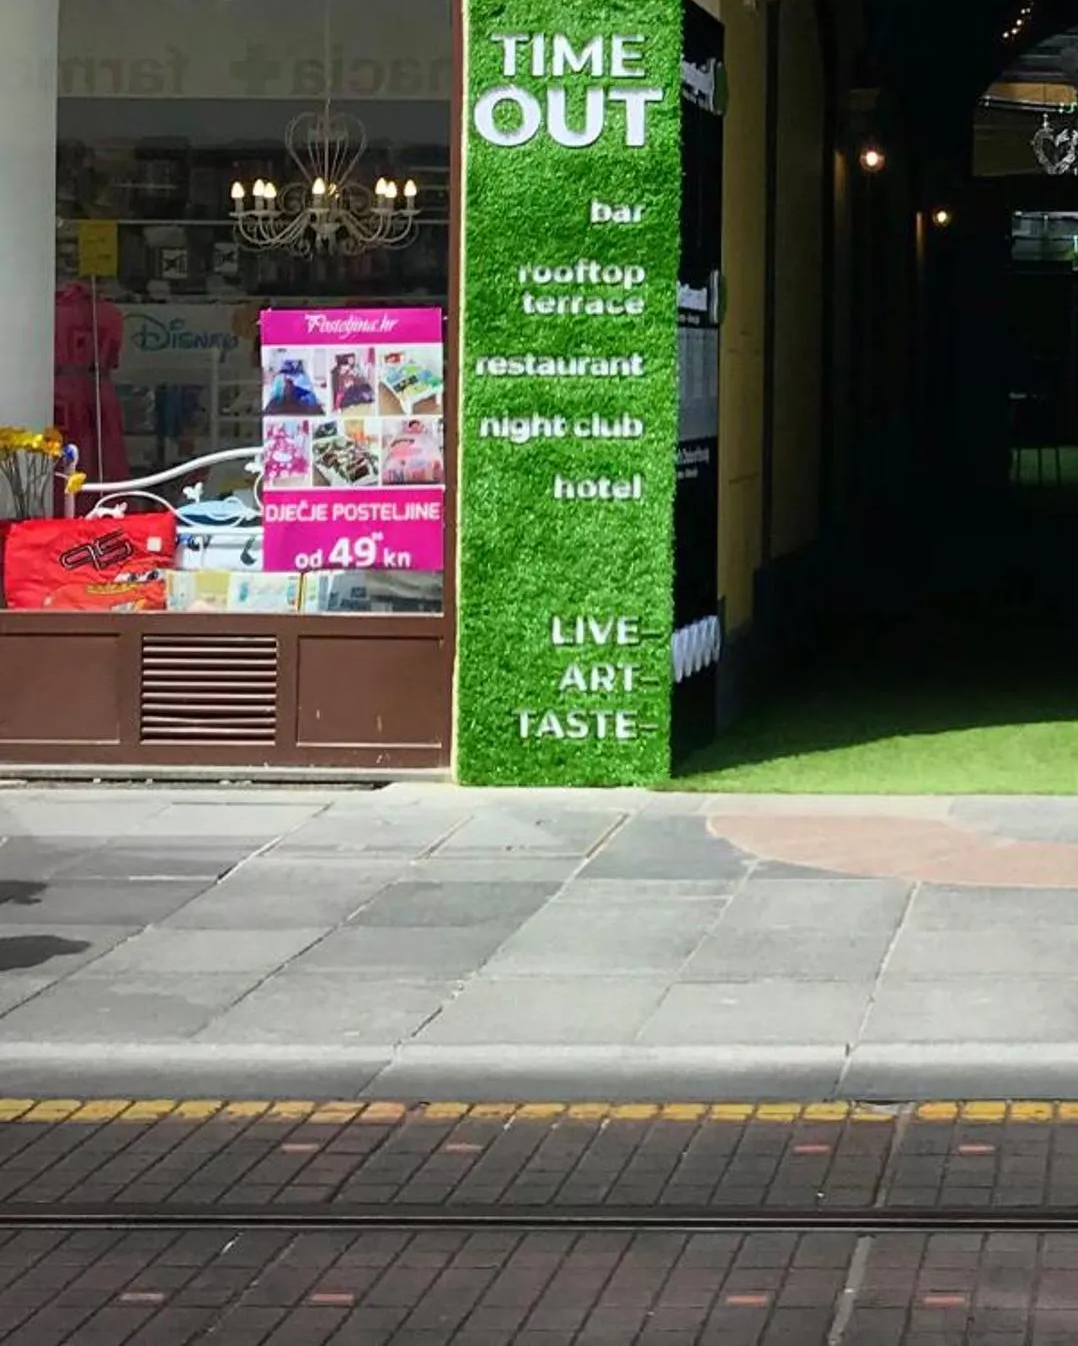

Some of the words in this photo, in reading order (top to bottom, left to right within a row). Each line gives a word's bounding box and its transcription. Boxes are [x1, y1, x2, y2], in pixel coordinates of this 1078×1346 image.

[491, 32, 647, 78] TIME
[473, 85, 663, 147] OUT
[589, 200, 645, 224] bar
[519, 259, 645, 289] rooftop
[522, 292, 645, 315] terrace
[475, 354, 645, 377] restaurant
[479, 413, 567, 443] night
[572, 413, 644, 439] club
[553, 474, 644, 500] hotel
[332, 502, 441, 522] POSTELJINE
[294, 549, 323, 569] od
[383, 547, 412, 568] kn
